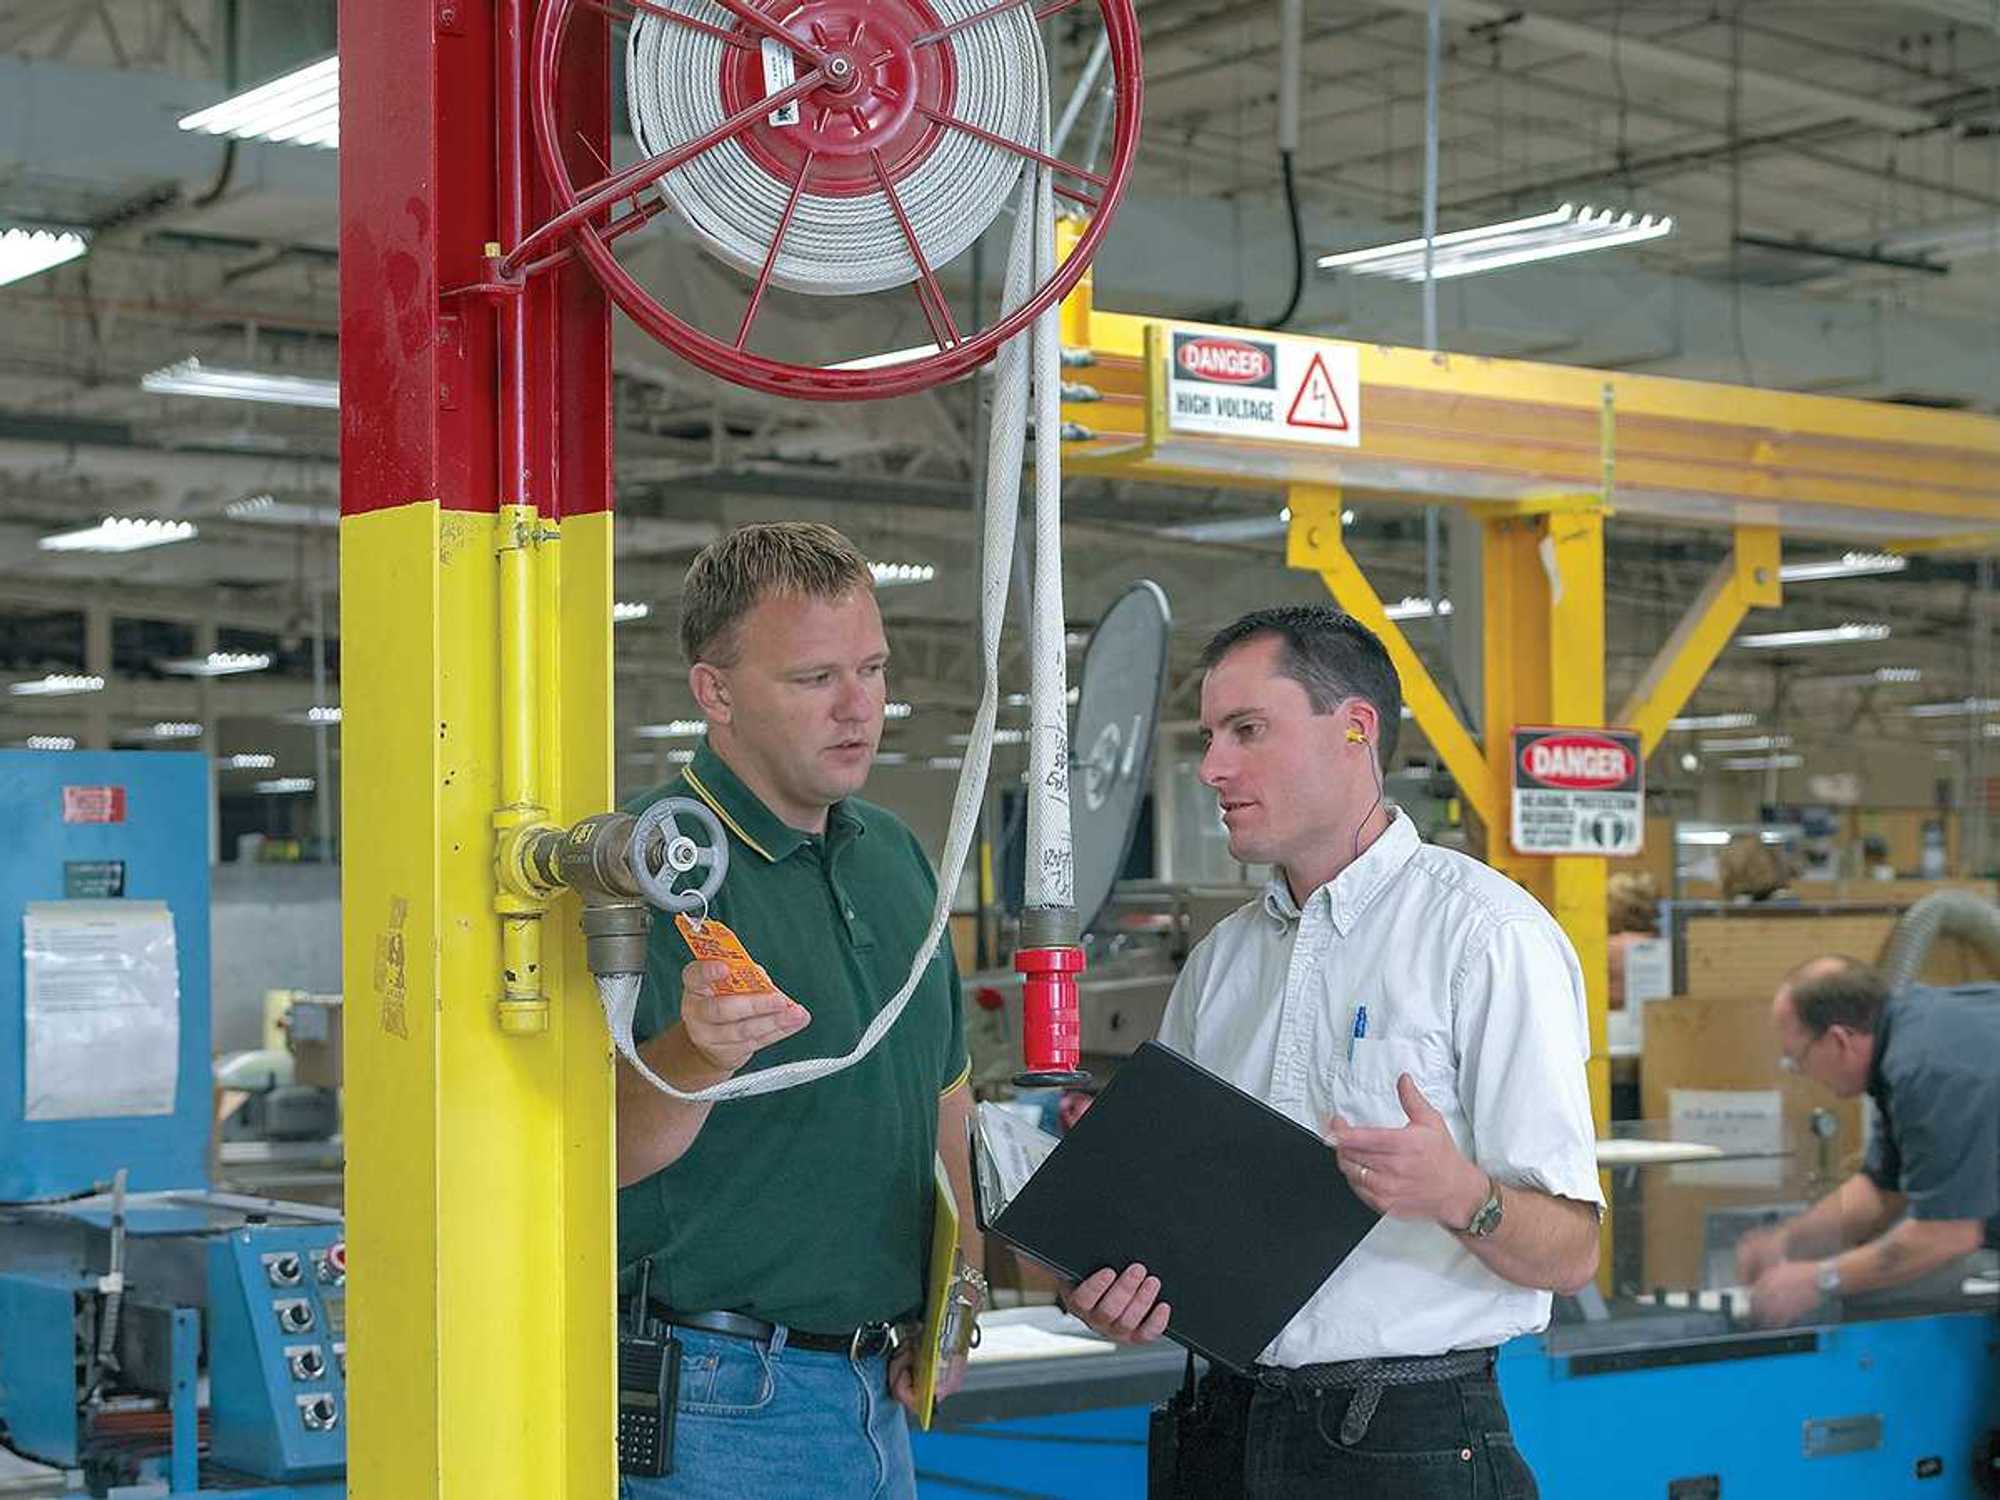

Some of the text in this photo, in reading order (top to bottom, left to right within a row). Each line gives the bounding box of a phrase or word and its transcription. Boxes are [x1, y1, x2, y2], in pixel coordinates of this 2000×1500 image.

[1184, 344, 1264, 374] DANGER
[1177, 391, 1275, 421] HIGH VOLTAGE
[1532, 745, 1626, 779] DANGER
